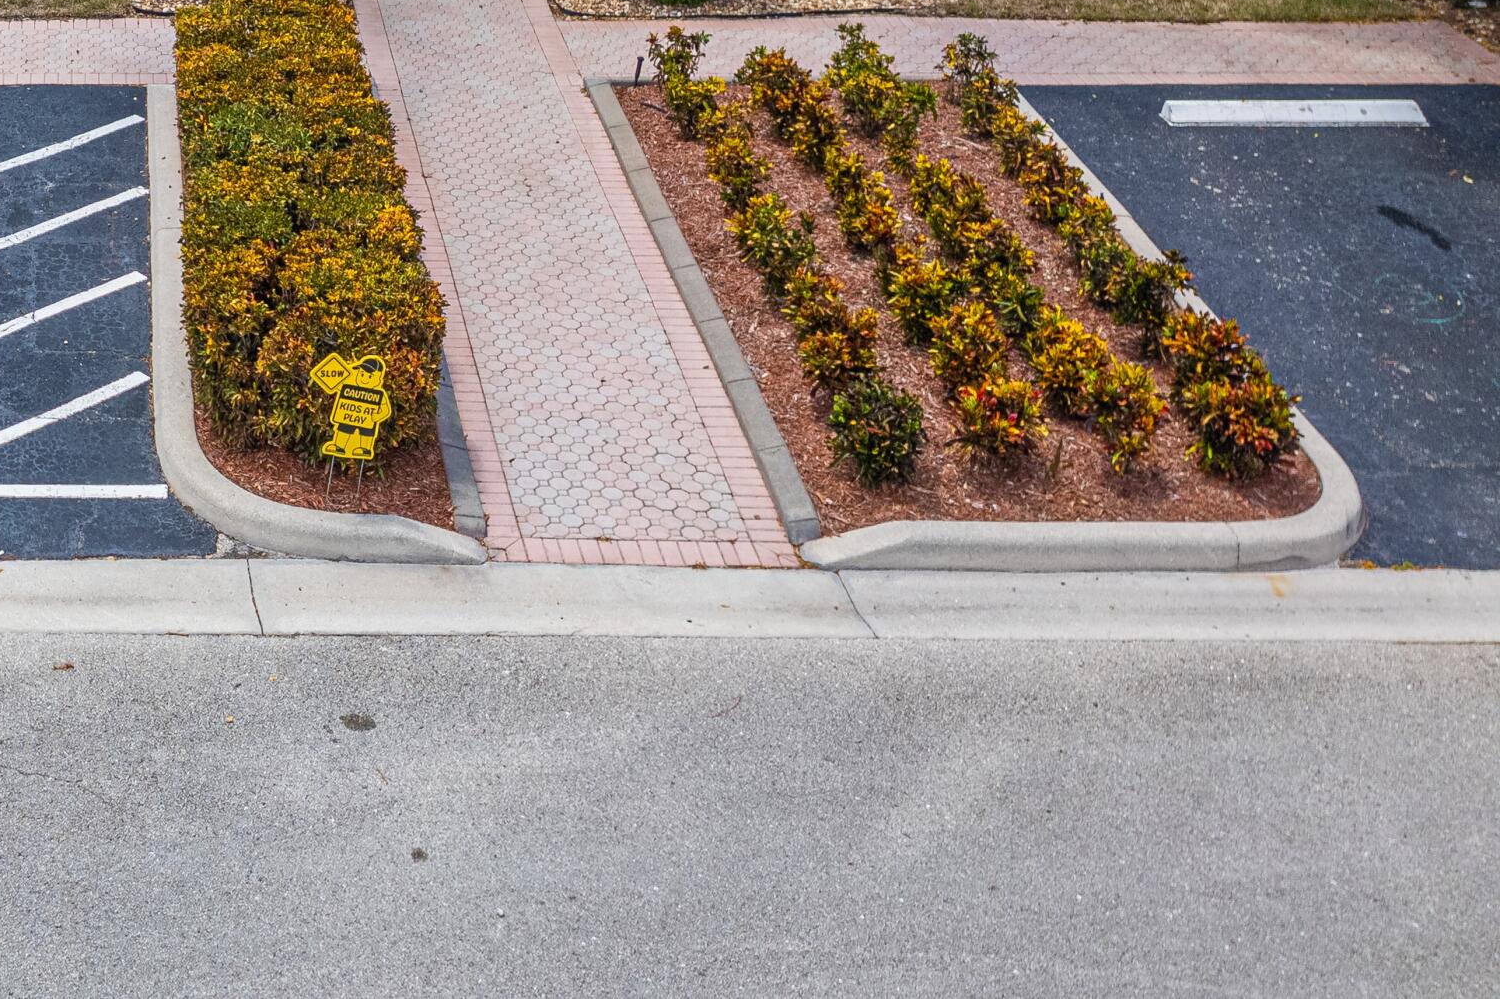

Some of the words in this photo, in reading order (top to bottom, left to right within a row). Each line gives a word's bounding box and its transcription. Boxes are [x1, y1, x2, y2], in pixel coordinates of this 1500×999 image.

[320, 370, 344, 378] SLOW
[343, 388, 380, 402] CAUTION
[340, 402, 362, 413] KIDS
[363, 407, 376, 416] AT
[343, 413, 367, 424] PLAY
